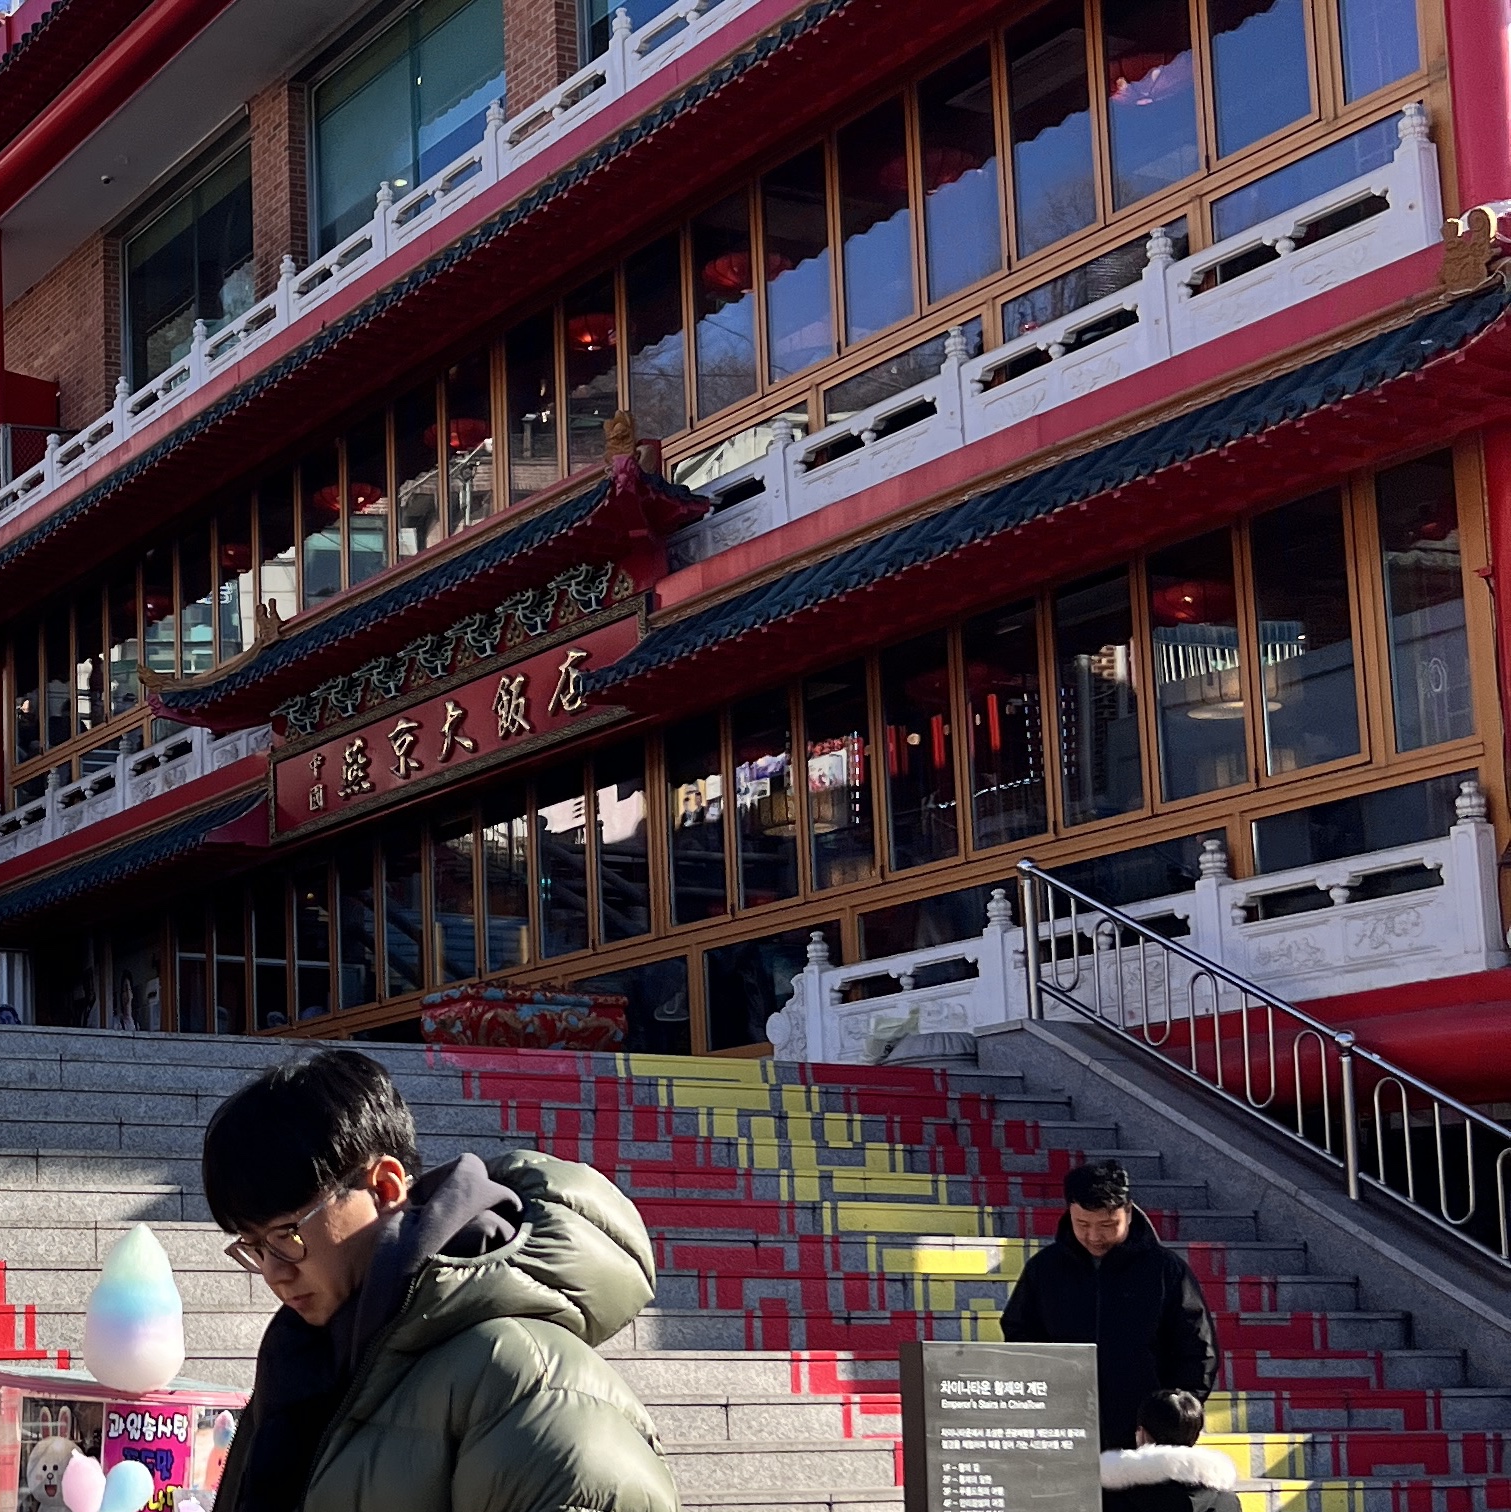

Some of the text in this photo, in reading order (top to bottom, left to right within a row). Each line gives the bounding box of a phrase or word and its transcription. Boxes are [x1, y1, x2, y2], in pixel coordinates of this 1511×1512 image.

[309, 753, 325, 811] 中國
[940, 1380, 1048, 1396] 차이나타운 황제의 계단
[978, 1399, 999, 1410] Stairs
[999, 1400, 1008, 1409] in
